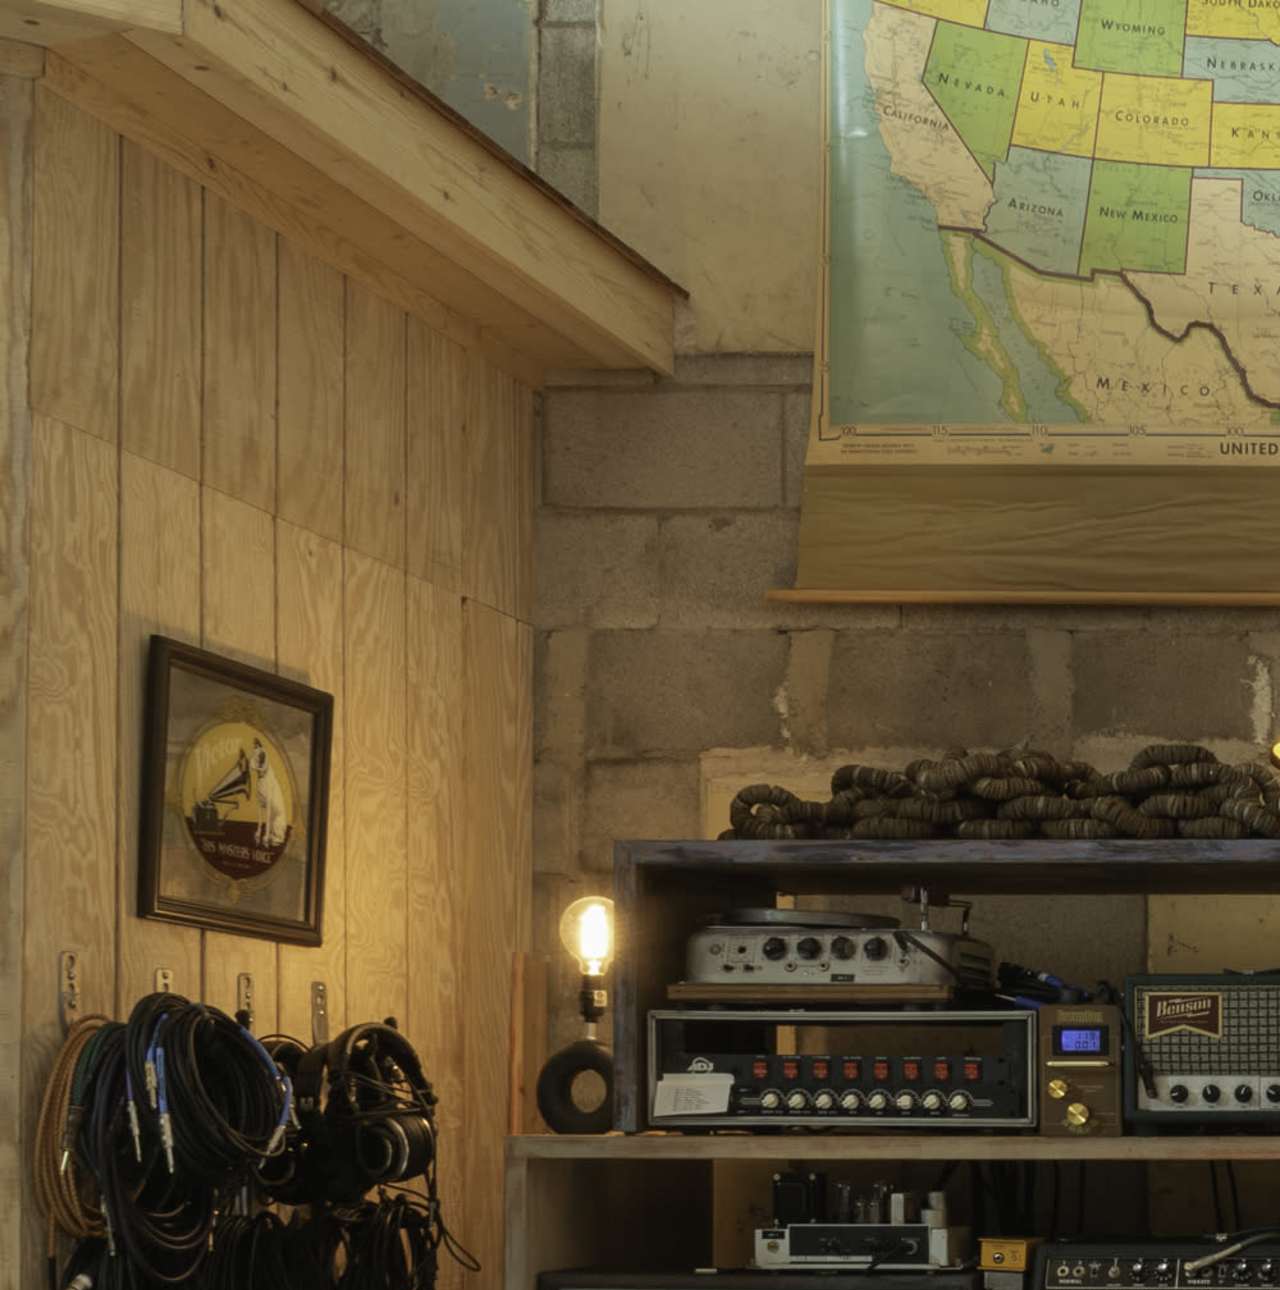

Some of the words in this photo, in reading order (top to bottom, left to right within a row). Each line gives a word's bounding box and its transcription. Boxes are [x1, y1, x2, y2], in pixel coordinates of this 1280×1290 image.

[1101, 19, 1166, 36] WYOMING
[938, 72, 1005, 97] NEVADA
[1031, 91, 1080, 109] UTAH
[883, 105, 949, 131] CALIFORNIA
[1115, 110, 1189, 127] COLORADO
[1008, 197, 1064, 217] ARIZONA
[1099, 206, 1127, 220] NEW
[1131, 208, 1178, 225] MEXICO
[1096, 377, 1211, 397] MEXICO
[1219, 442, 1279, 455] UNITED
[1156, 998, 1212, 1017] Benson
